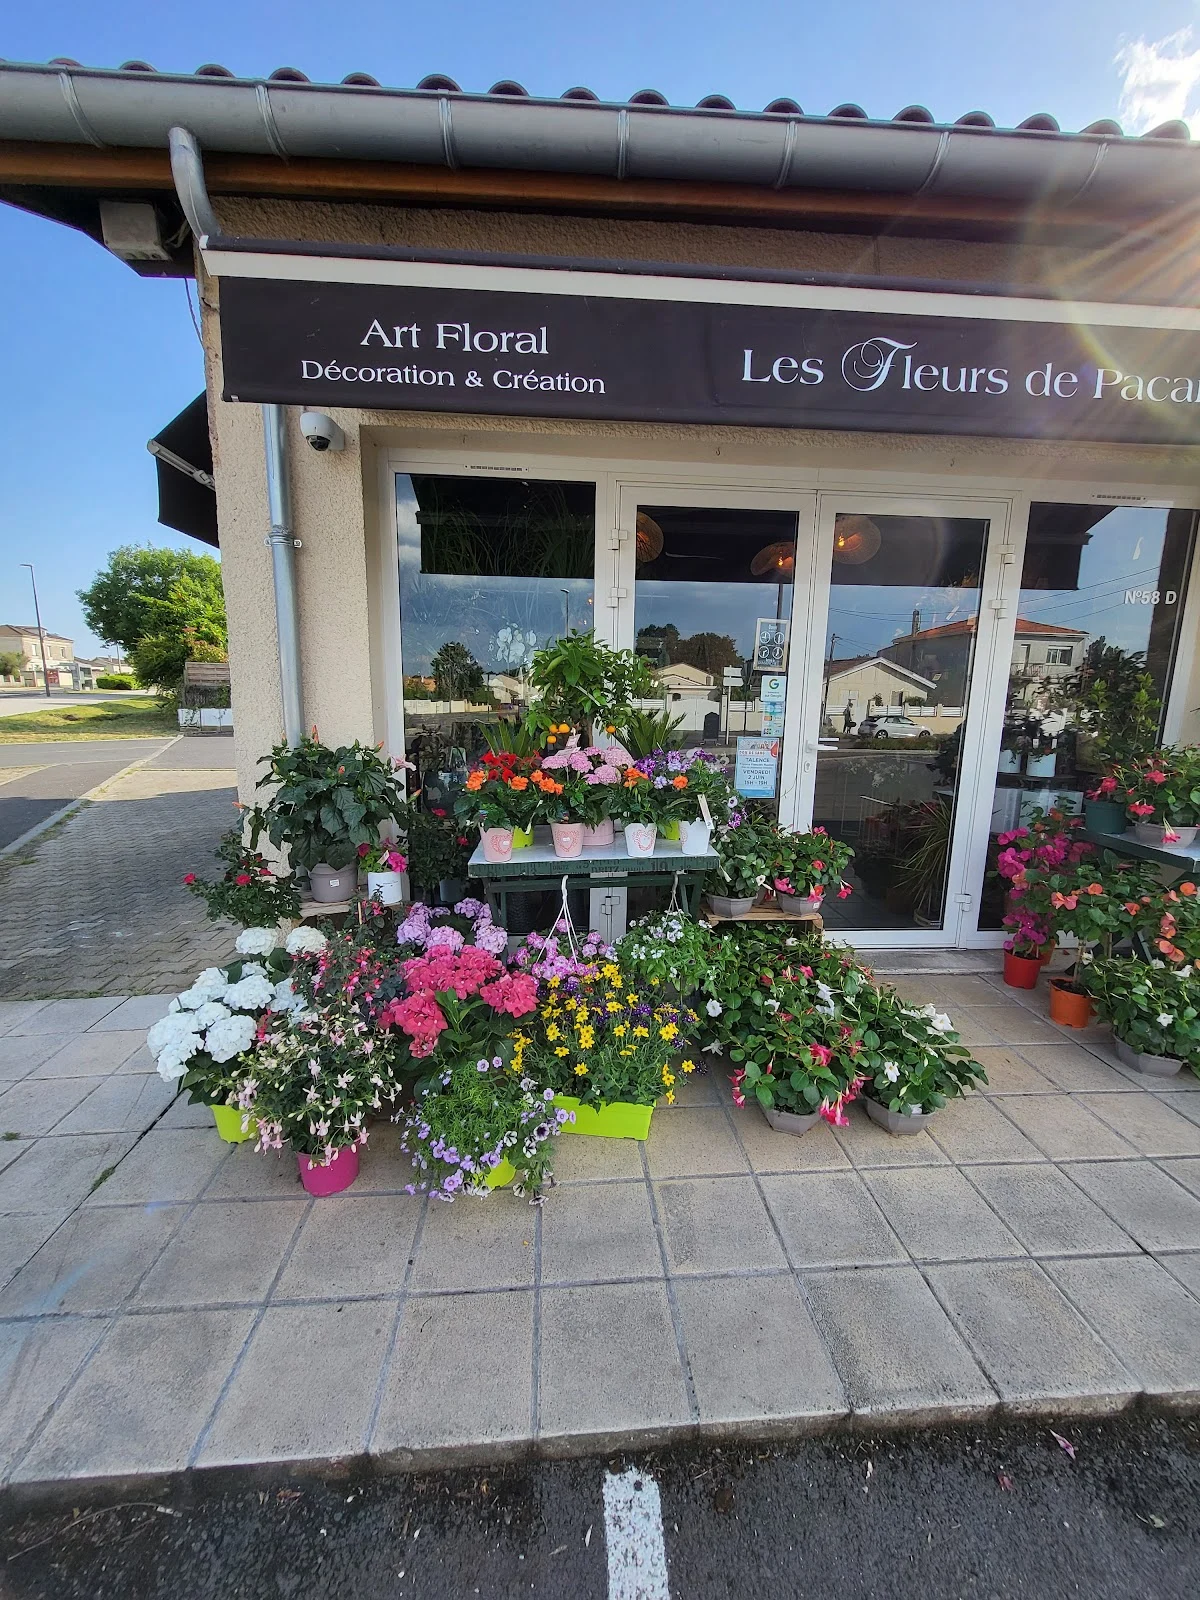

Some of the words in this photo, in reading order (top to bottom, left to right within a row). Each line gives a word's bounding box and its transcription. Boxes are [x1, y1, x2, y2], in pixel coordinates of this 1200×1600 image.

[360, 319, 421, 349] Art
[435, 323, 549, 355] Floral
[300, 359, 455, 388] Décoration
[465, 371, 483, 388] &
[492, 369, 606, 394] Création
[741, 349, 825, 385] Les
[841, 337, 1010, 395] Fleurs
[1025, 362, 1079, 398] de
[1165, 590, 1177, 605] D
